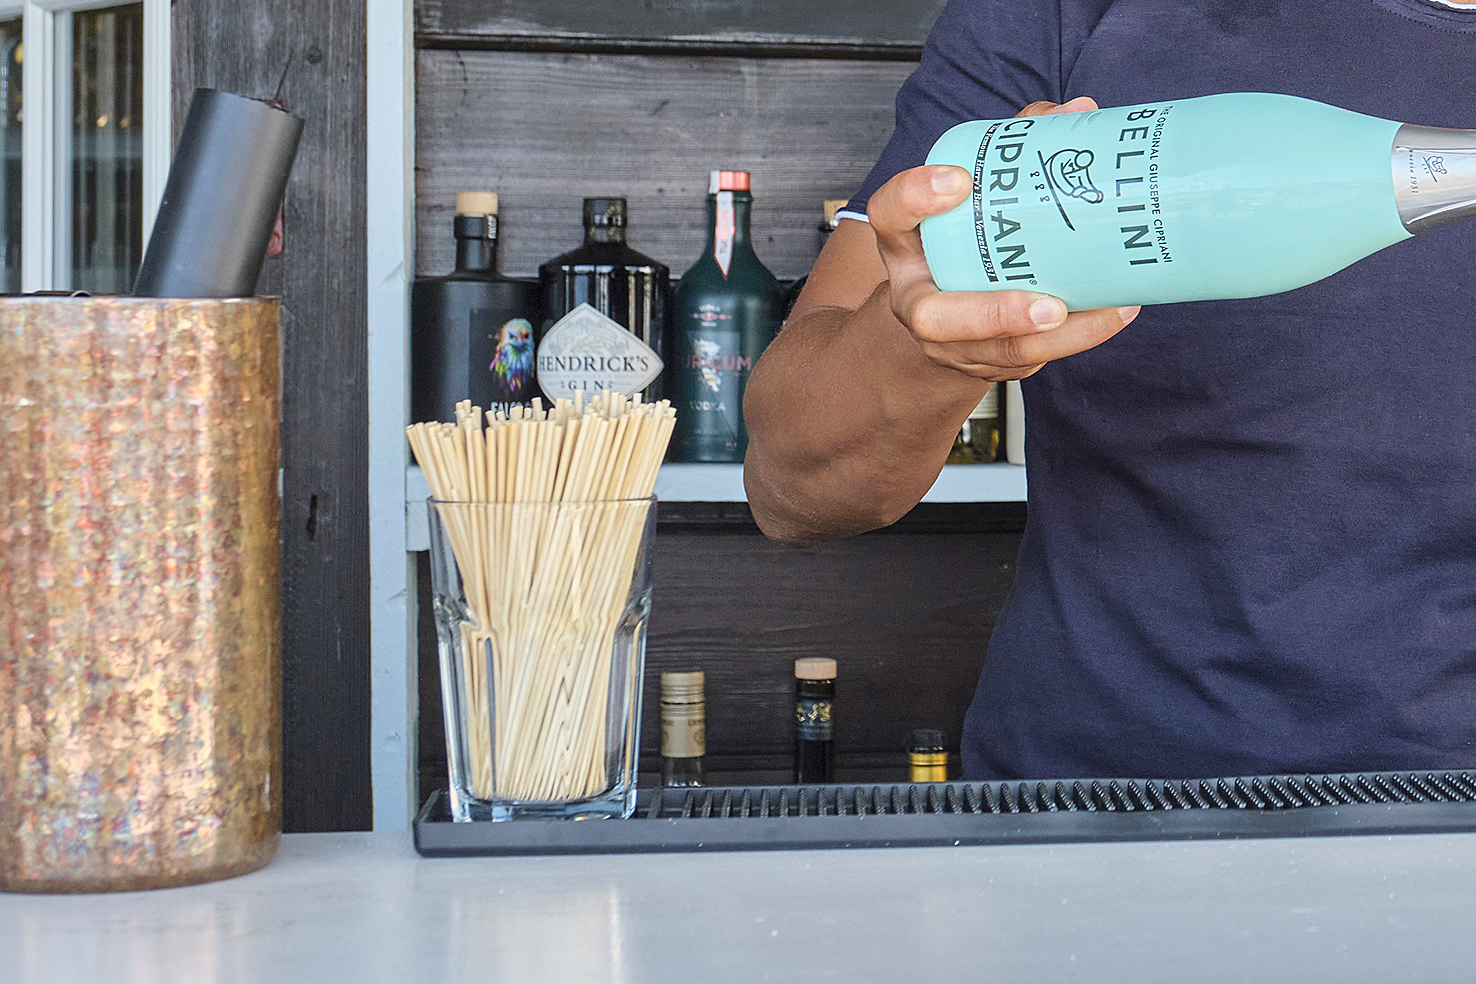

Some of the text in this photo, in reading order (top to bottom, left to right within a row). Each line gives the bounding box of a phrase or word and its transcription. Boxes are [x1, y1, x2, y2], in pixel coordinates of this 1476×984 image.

[1149, 117, 1167, 160] ORIGINAL
[973, 159, 985, 191] Harry's
[1115, 108, 1158, 266] BELLINI
[1149, 163, 1161, 215] GIUSEPPE
[1410, 176, 1419, 194] 1931
[973, 192, 982, 209] Bar
[989, 119, 1036, 282] CIPRIANI
[975, 220, 988, 255] Venezia
[1153, 219, 1174, 264] CIPRIANI
[983, 256, 997, 278] 1931
[540, 356, 650, 372] HENDRICK'S
[568, 380, 604, 391] GIN
